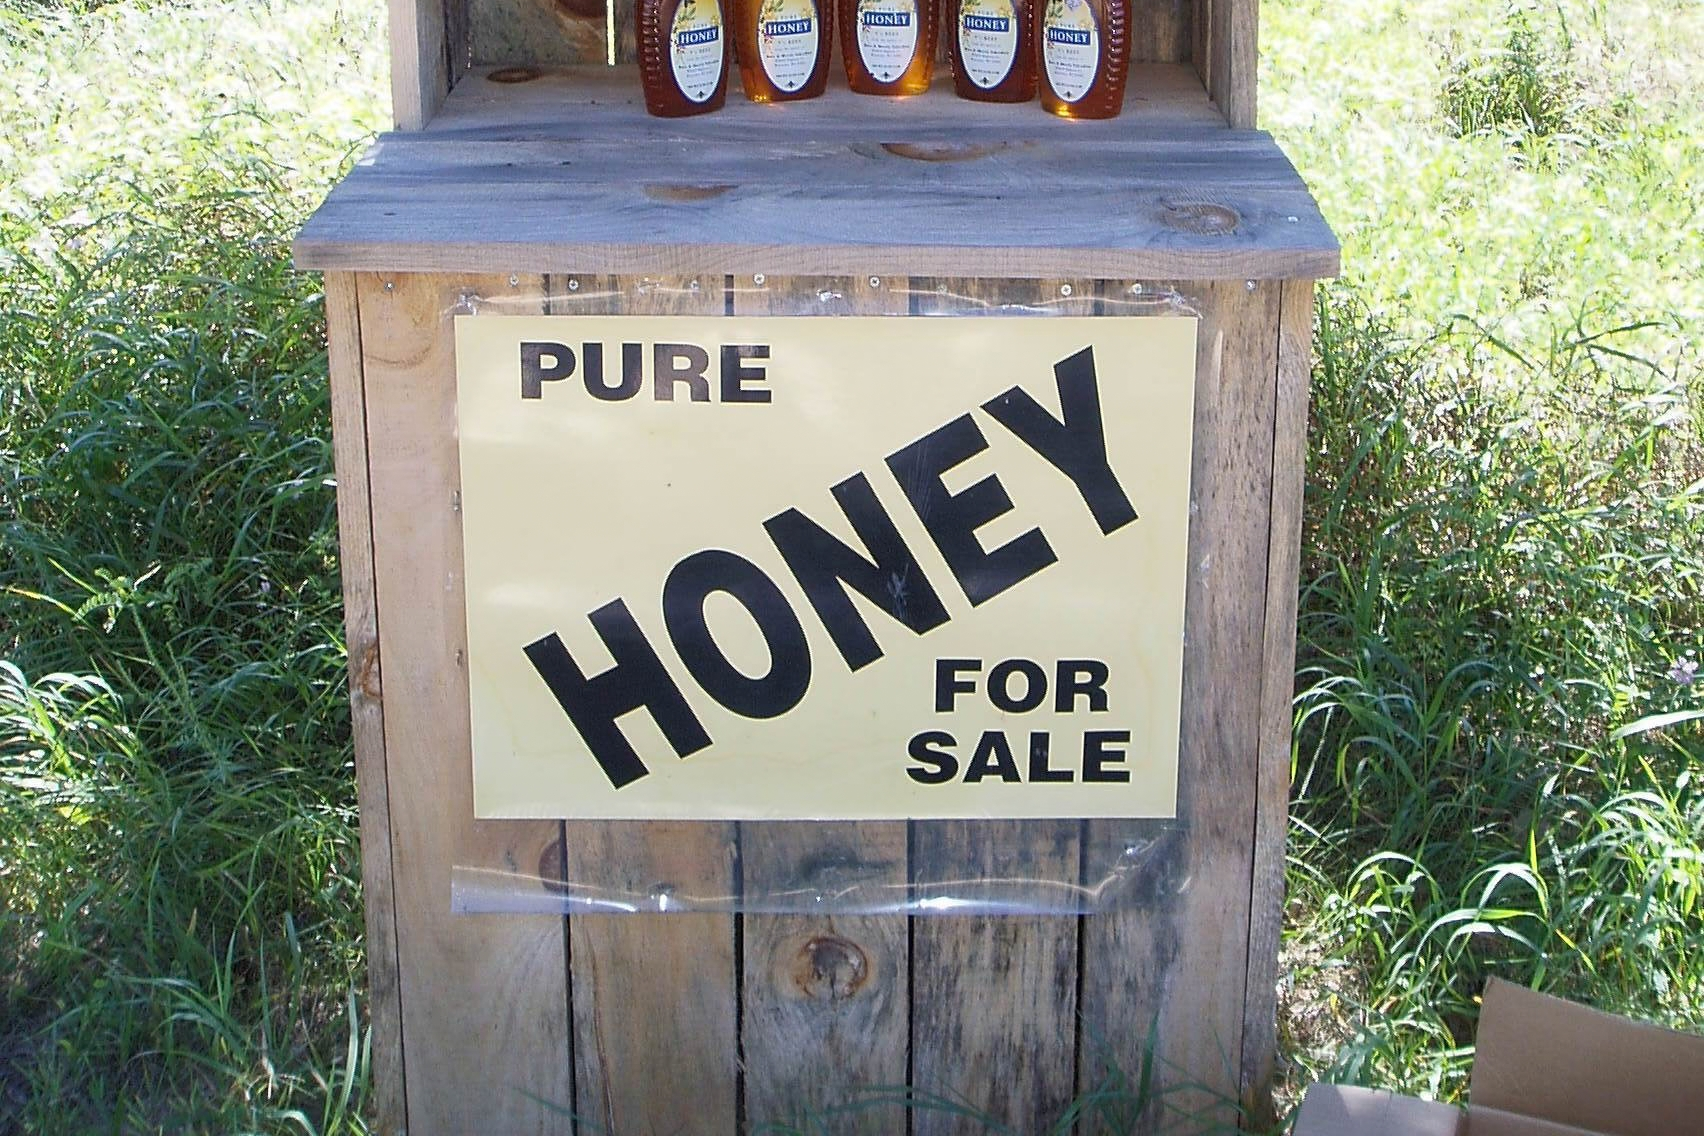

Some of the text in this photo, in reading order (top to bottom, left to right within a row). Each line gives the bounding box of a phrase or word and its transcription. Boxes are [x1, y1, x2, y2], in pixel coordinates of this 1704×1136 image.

[866, 14, 907, 25] HONEY
[966, 17, 1007, 30] HONEY
[768, 21, 809, 35] HONEY
[679, 29, 717, 45] HONEY
[1050, 30, 1088, 44] HONEY
[521, 342, 773, 403] PURE
[521, 344, 1140, 790] HONEY
[934, 658, 1110, 714] FOR
[905, 730, 1132, 784] SALE
